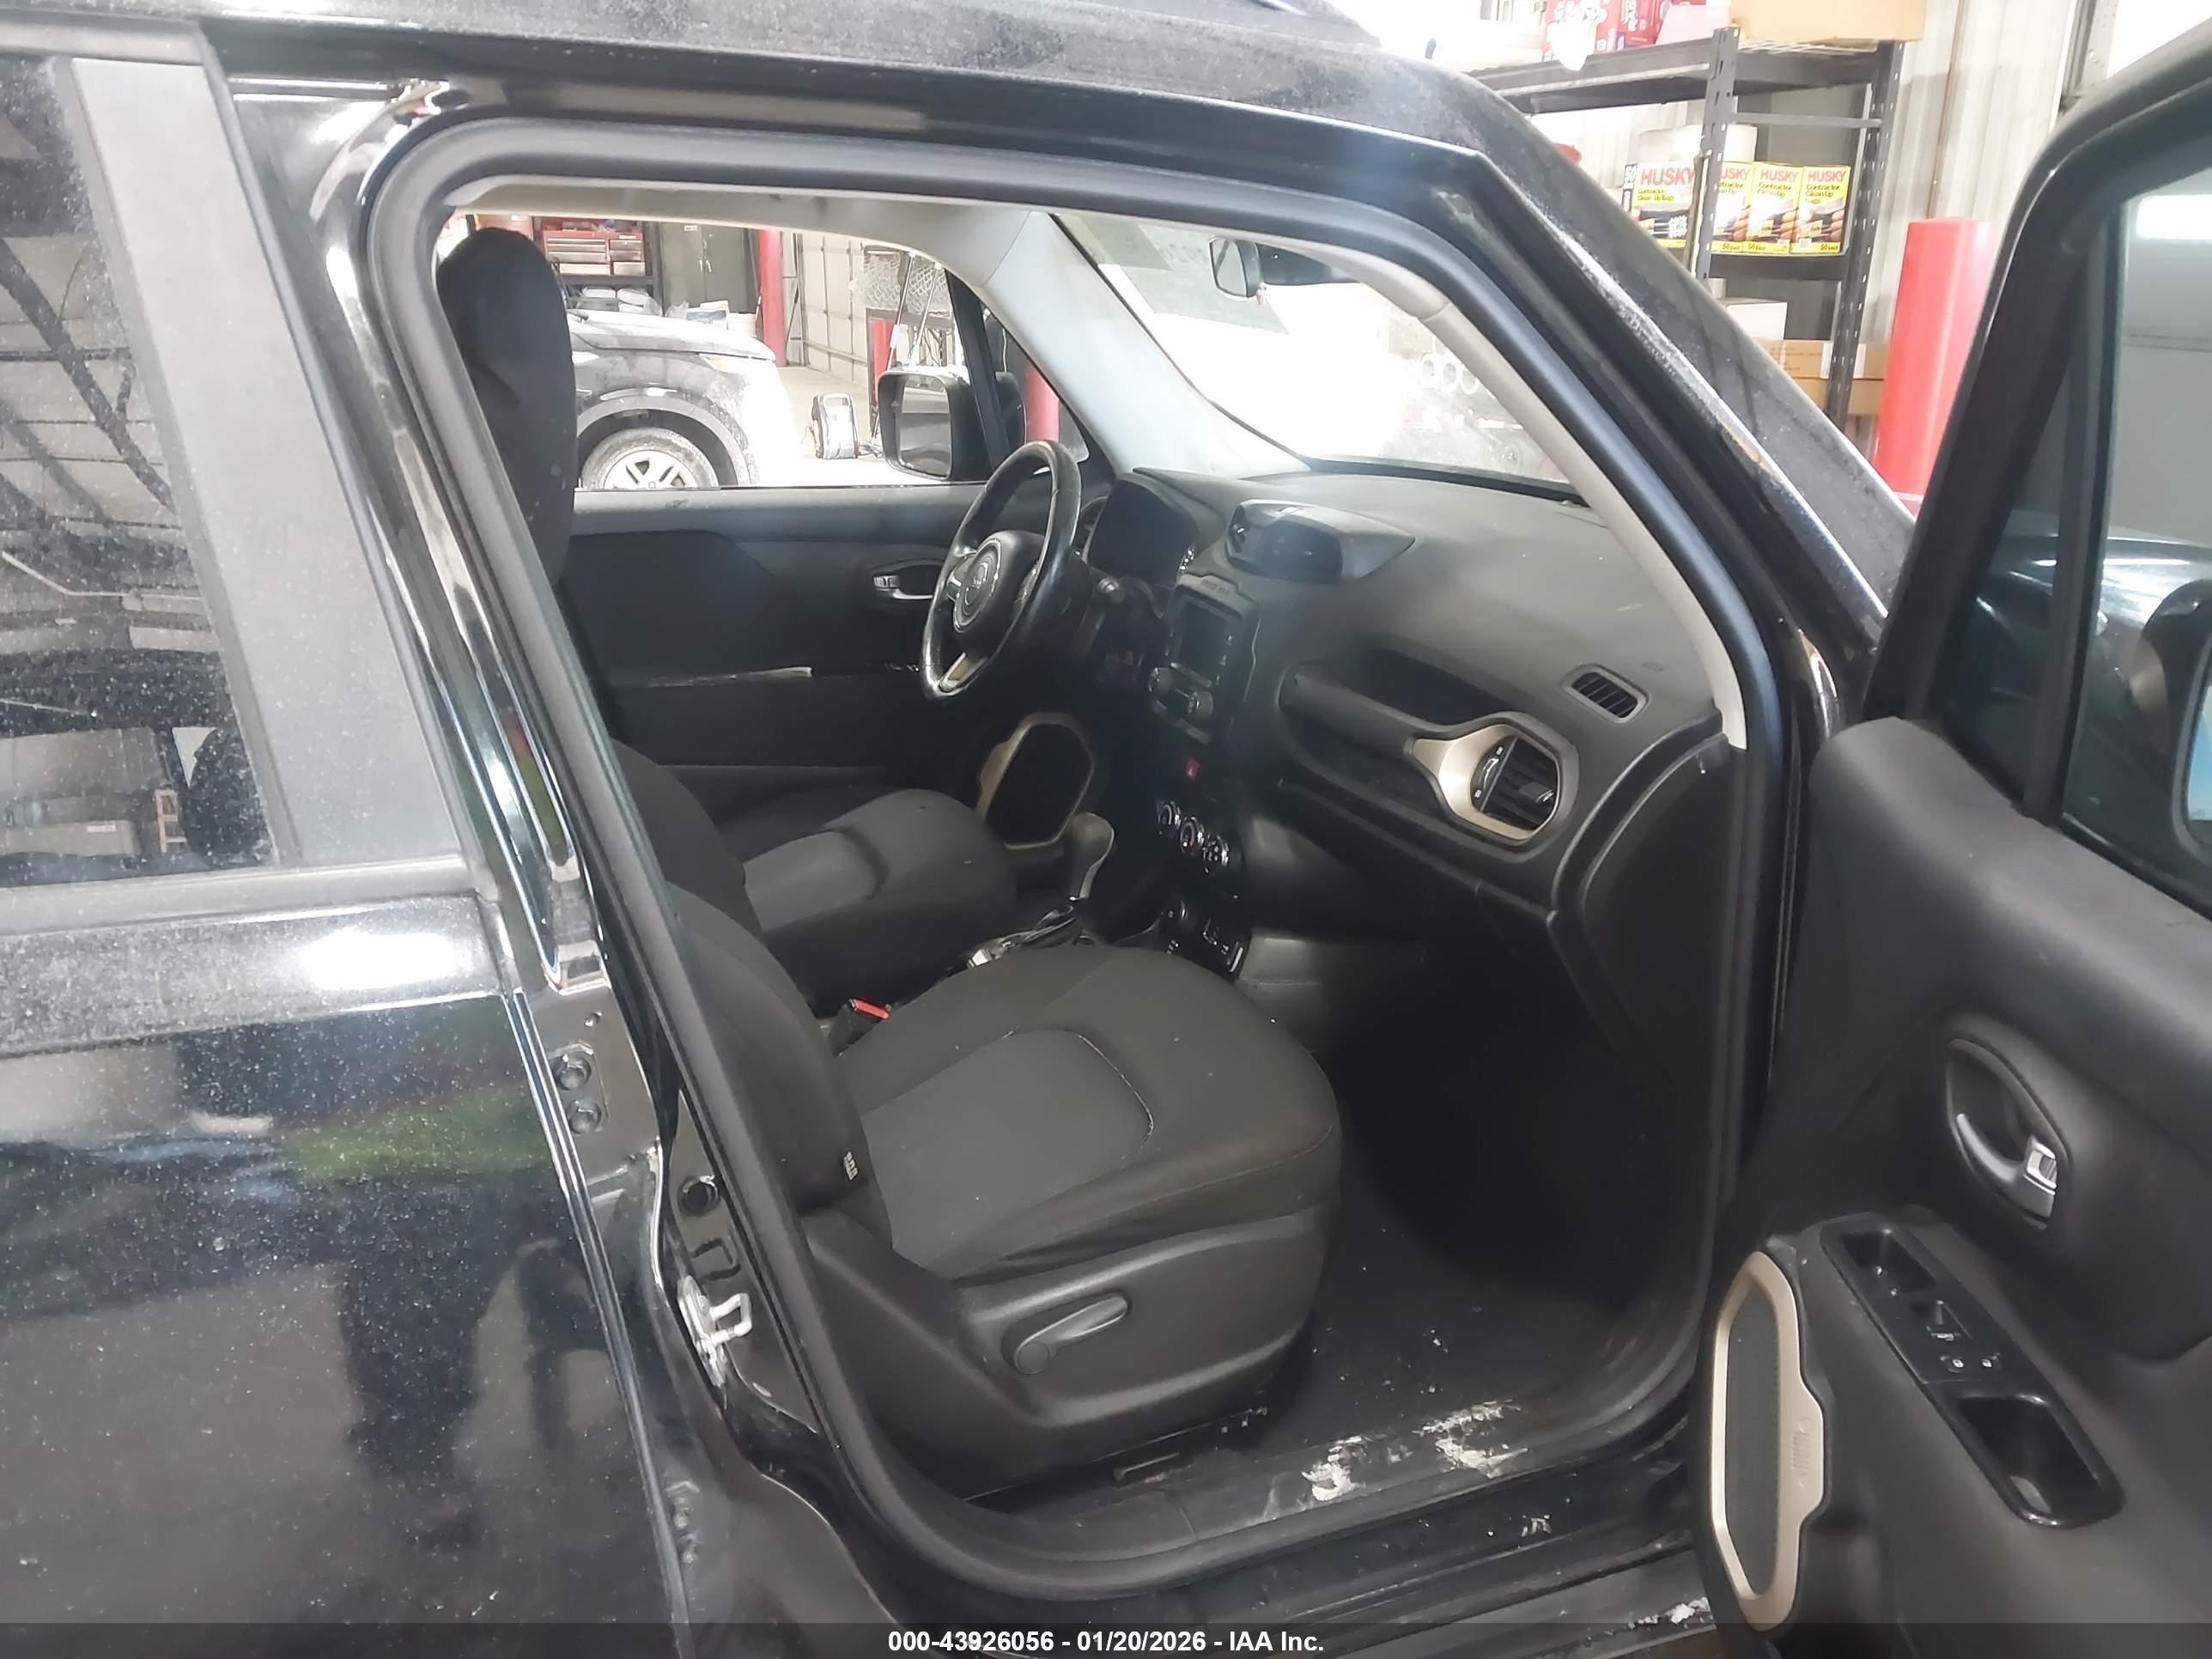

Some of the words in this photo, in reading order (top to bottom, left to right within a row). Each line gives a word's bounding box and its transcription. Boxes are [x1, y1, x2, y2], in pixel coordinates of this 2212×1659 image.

[1720, 168, 1751, 179] USKY
[1760, 169, 1799, 183] HUSKY
[1808, 170, 1848, 183] HUSKY
[1759, 182, 1792, 191] Contractor
